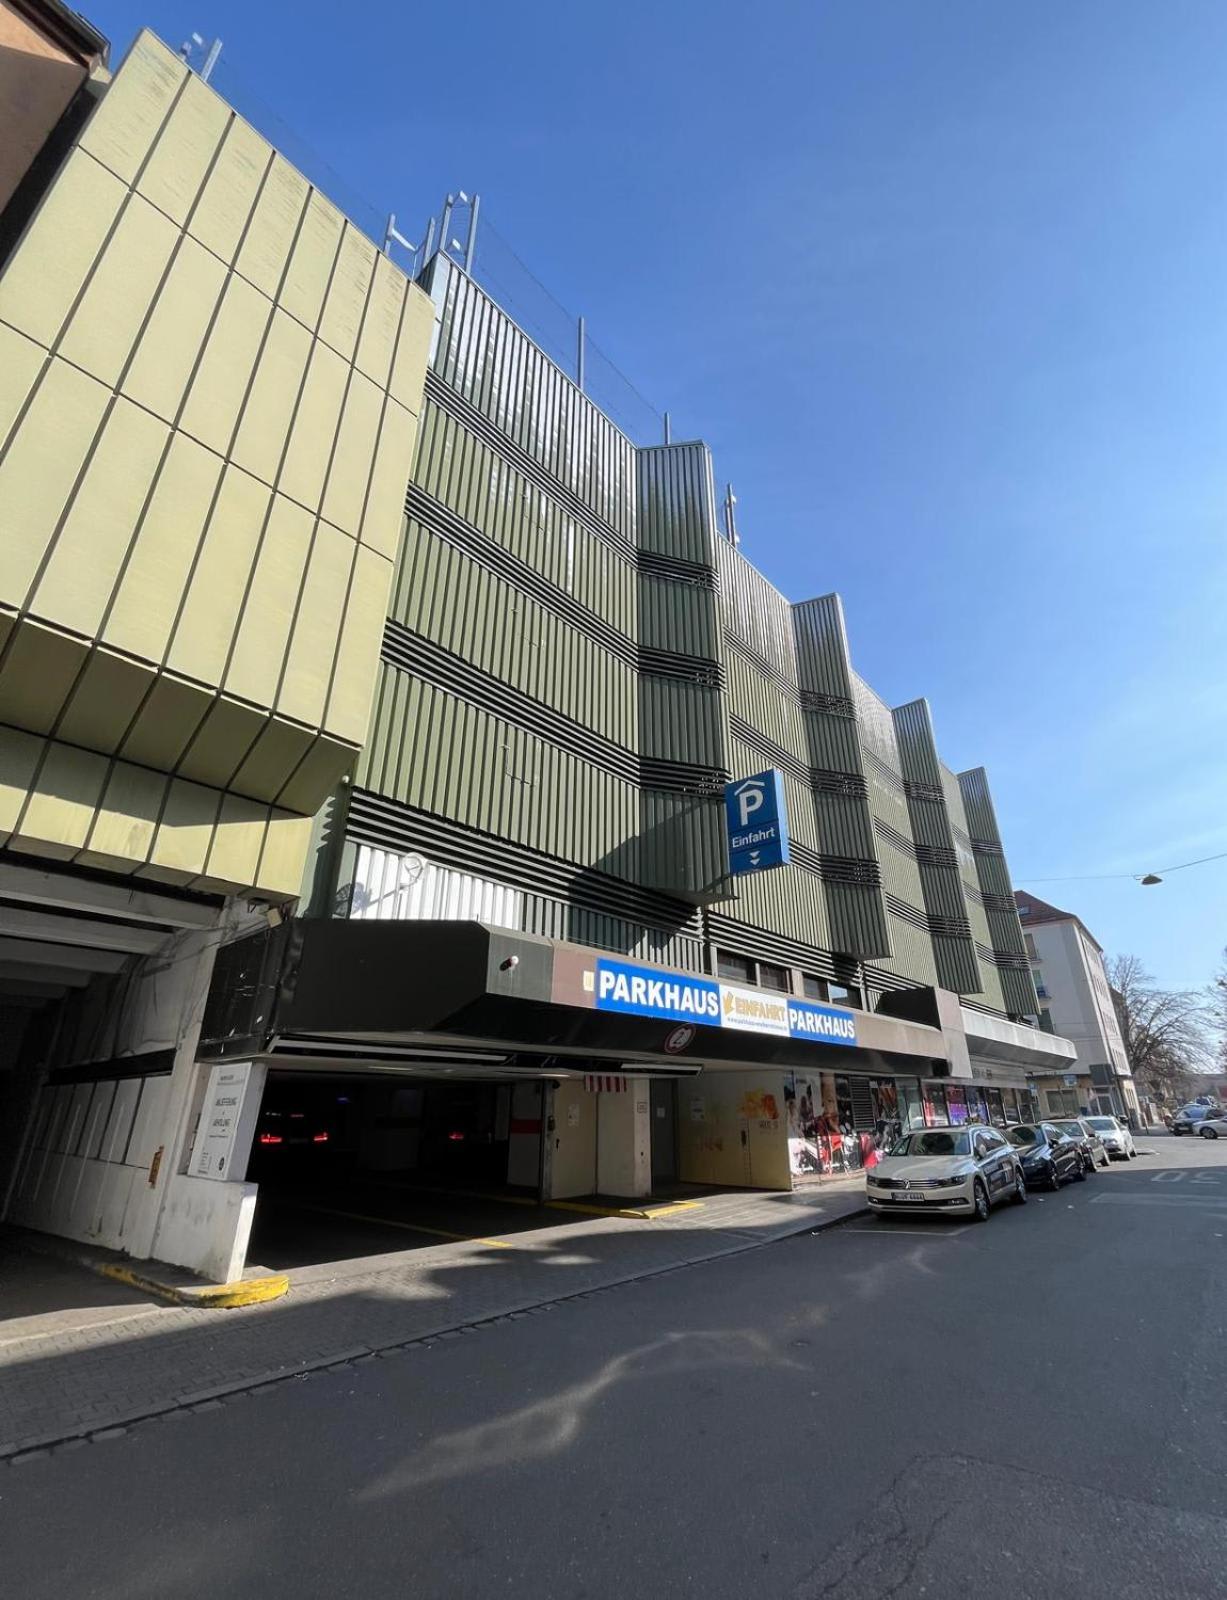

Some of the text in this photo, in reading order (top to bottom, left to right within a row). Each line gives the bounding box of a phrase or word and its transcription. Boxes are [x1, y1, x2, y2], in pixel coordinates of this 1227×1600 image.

[739, 789, 763, 826] P
[732, 827, 775, 848] Einfahrt
[599, 969, 719, 1017] PARKHAUS
[735, 997, 786, 1022] EINFAHRT
[788, 1008, 856, 1039] PARKHAUS
